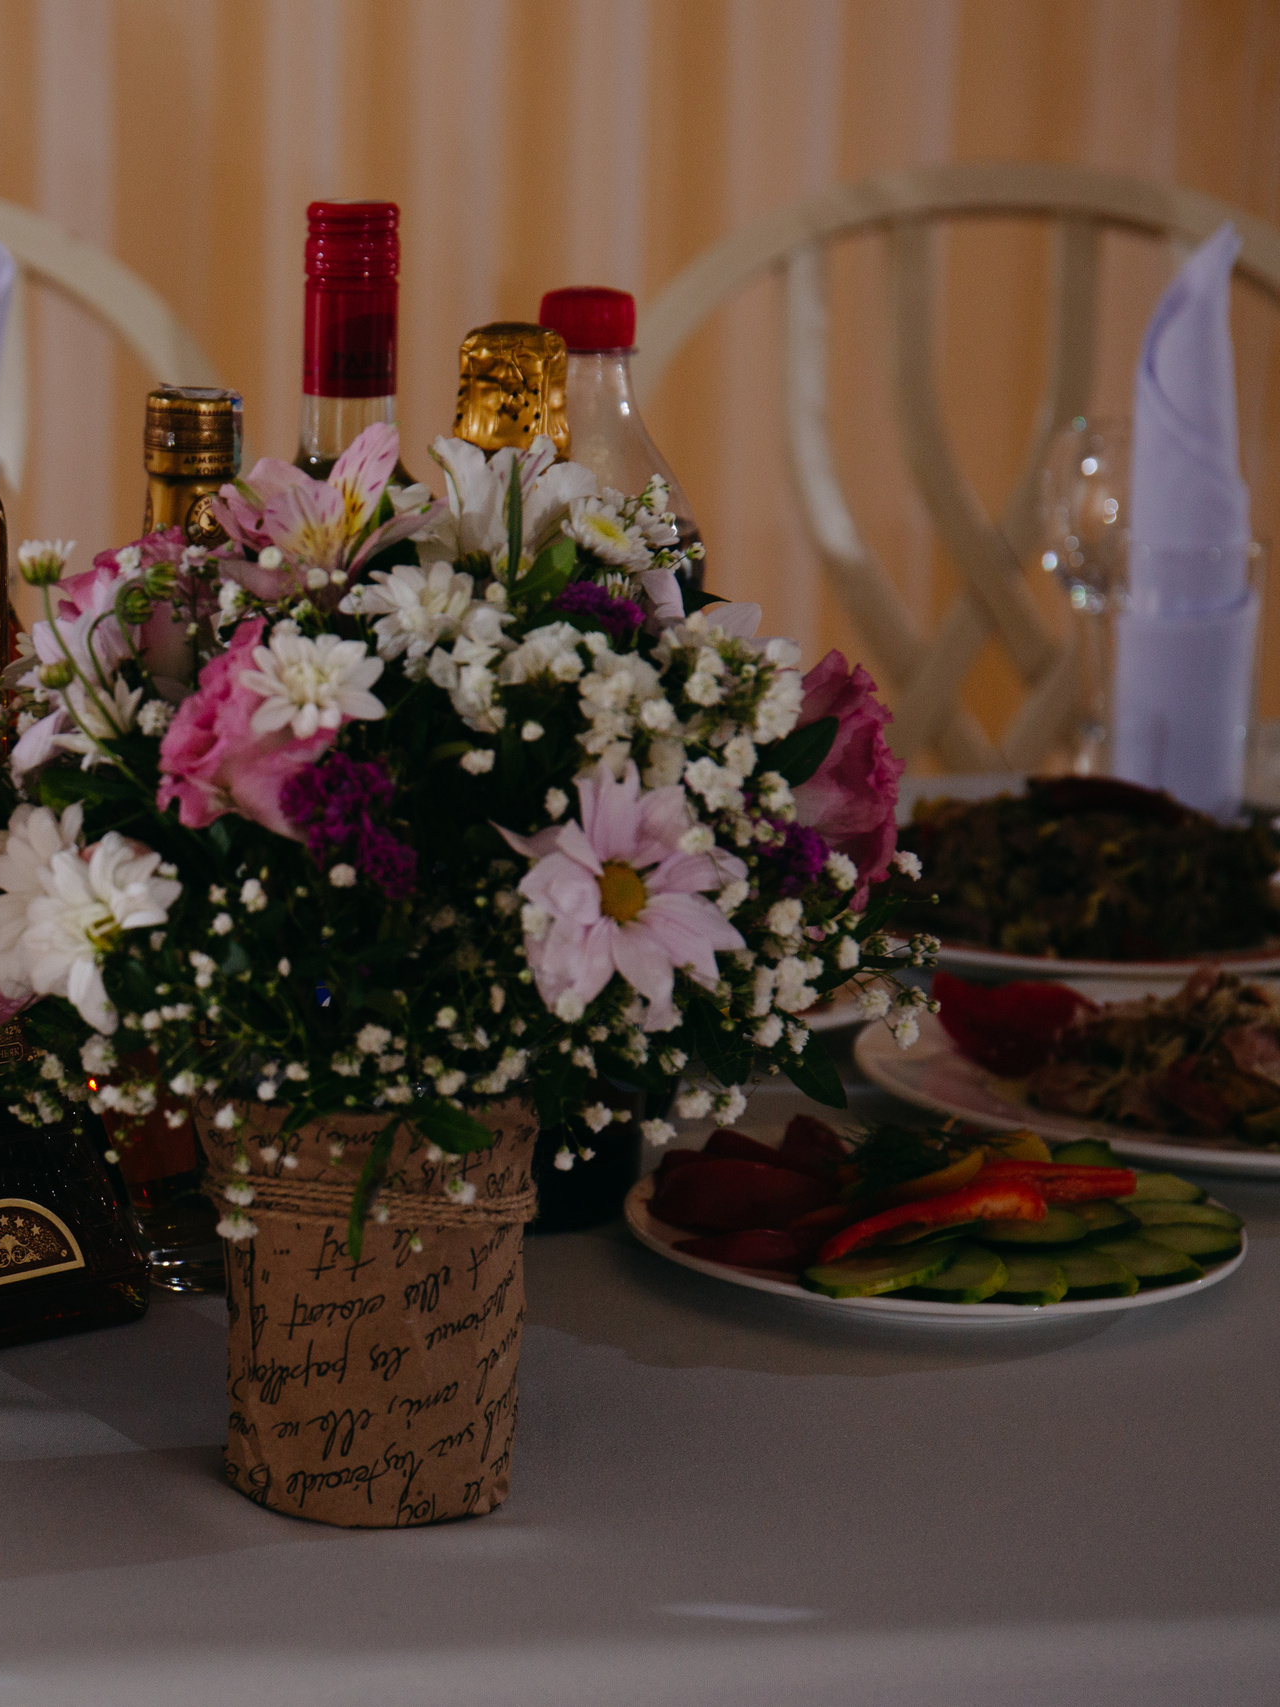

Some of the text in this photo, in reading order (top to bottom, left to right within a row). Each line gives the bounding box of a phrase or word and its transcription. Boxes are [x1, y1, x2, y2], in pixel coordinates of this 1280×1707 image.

[5, 1024, 22, 1036] 42%
[403, 1267, 451, 1314] elles
[369, 1344, 410, 1382] les
[306, 1409, 376, 1461] elle
